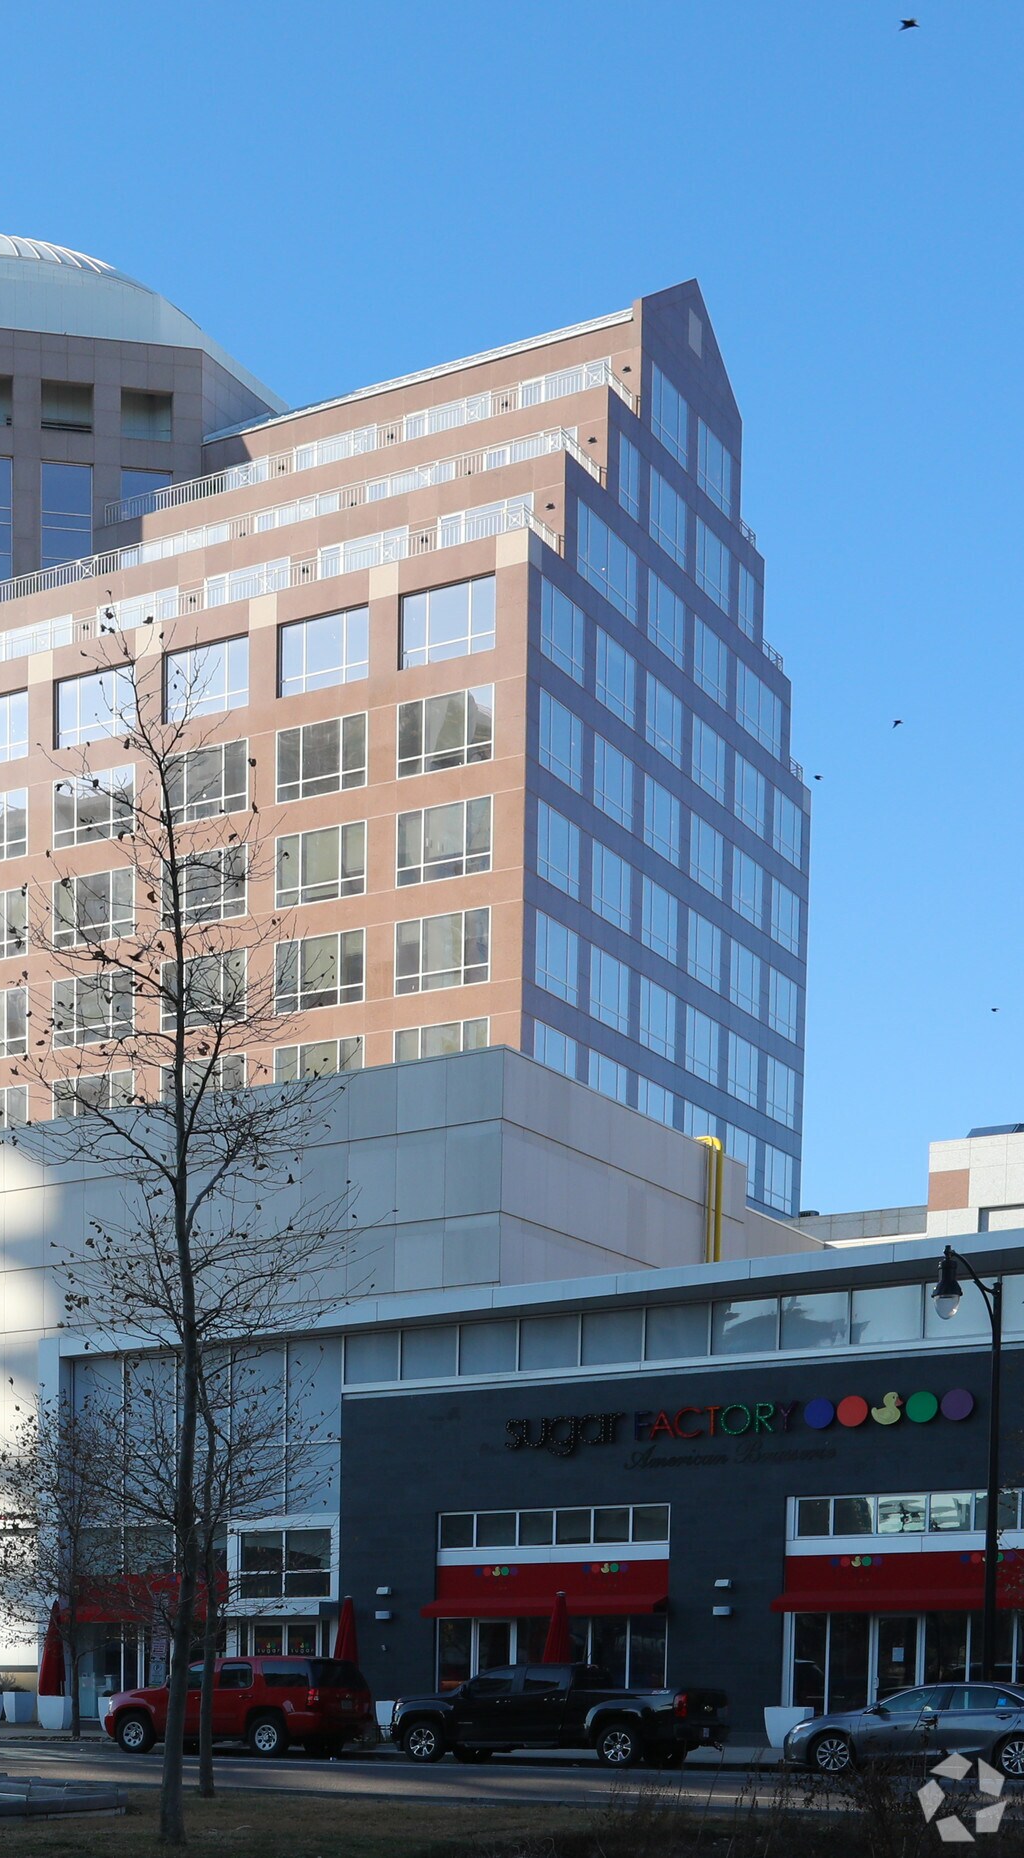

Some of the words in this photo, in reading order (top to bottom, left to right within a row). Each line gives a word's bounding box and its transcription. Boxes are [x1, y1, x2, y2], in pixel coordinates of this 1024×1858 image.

[505, 1411, 625, 1457] sugar
[634, 1400, 799, 1442] FACTORY
[624, 1444, 729, 1471] American
